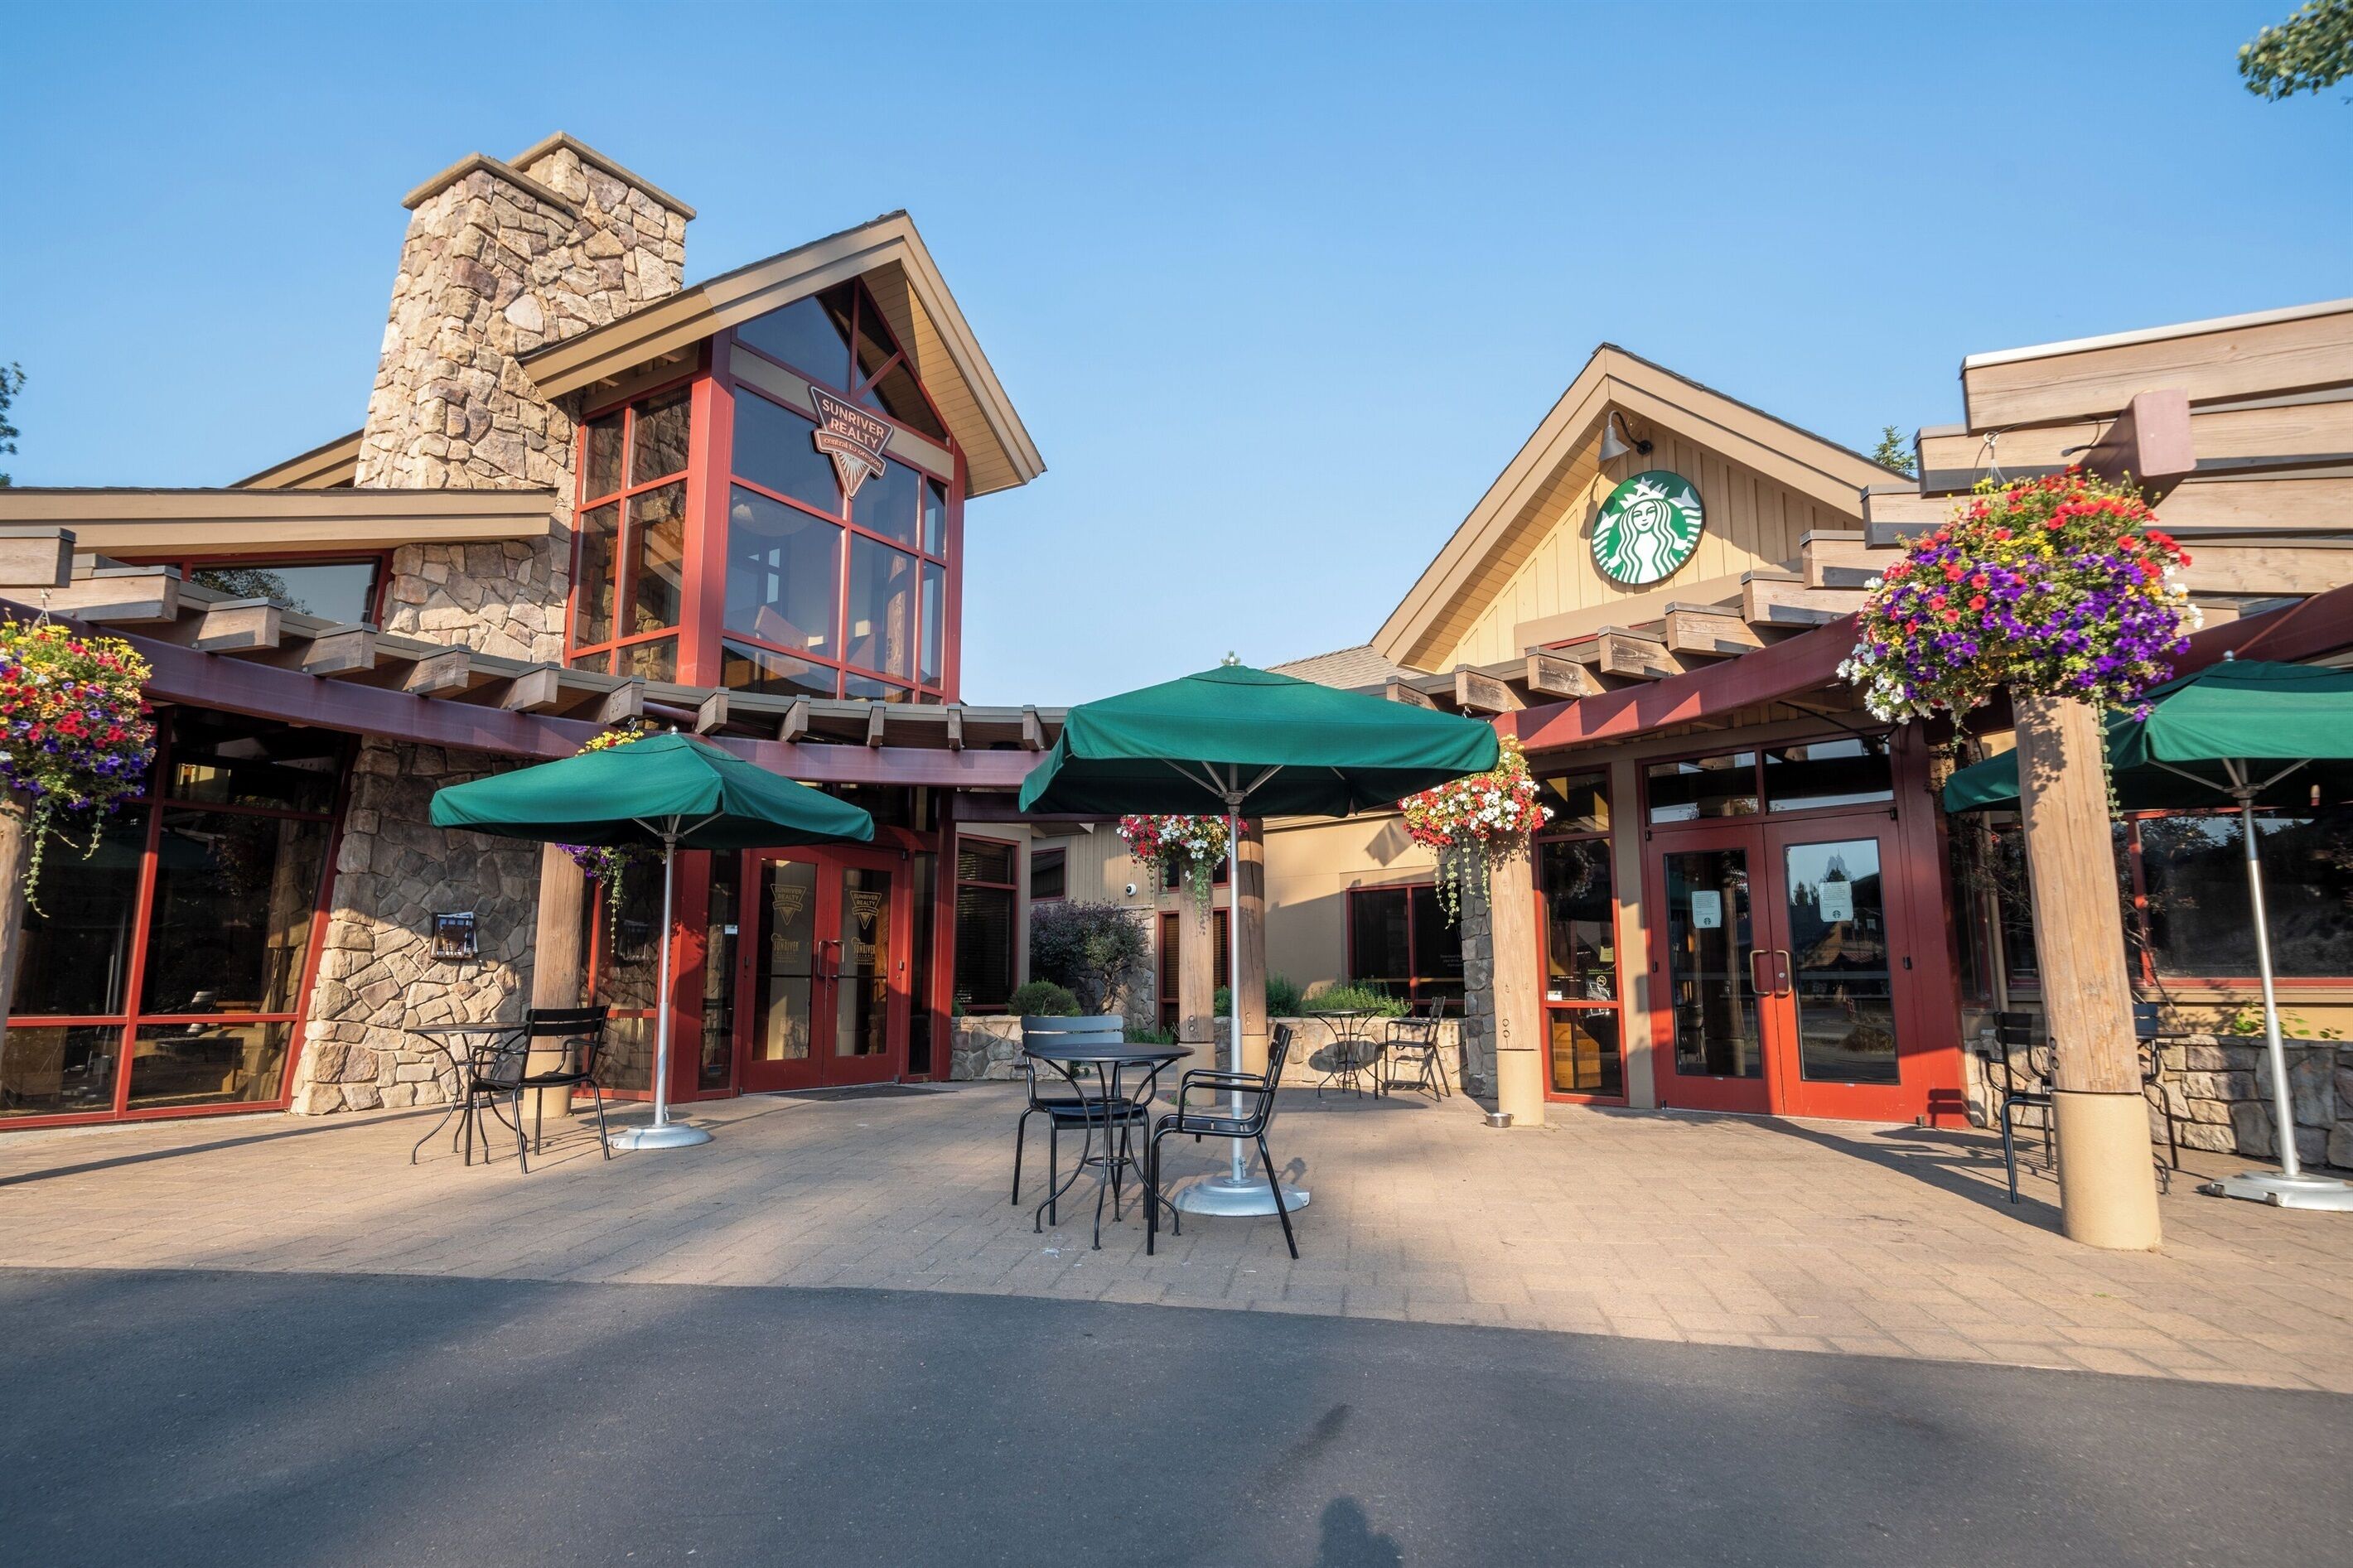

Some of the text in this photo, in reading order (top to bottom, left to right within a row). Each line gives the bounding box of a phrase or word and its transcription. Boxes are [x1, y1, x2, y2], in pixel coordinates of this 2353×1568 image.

[822, 398, 884, 438] SUNRIVER
[830, 417, 877, 448] REALTY
[824, 438, 848, 448] central
[849, 444, 858, 452] to
[858, 450, 882, 468] oregon
[774, 939, 800, 951] SUNRIVER
[853, 943, 875, 954] SUNRIVER
